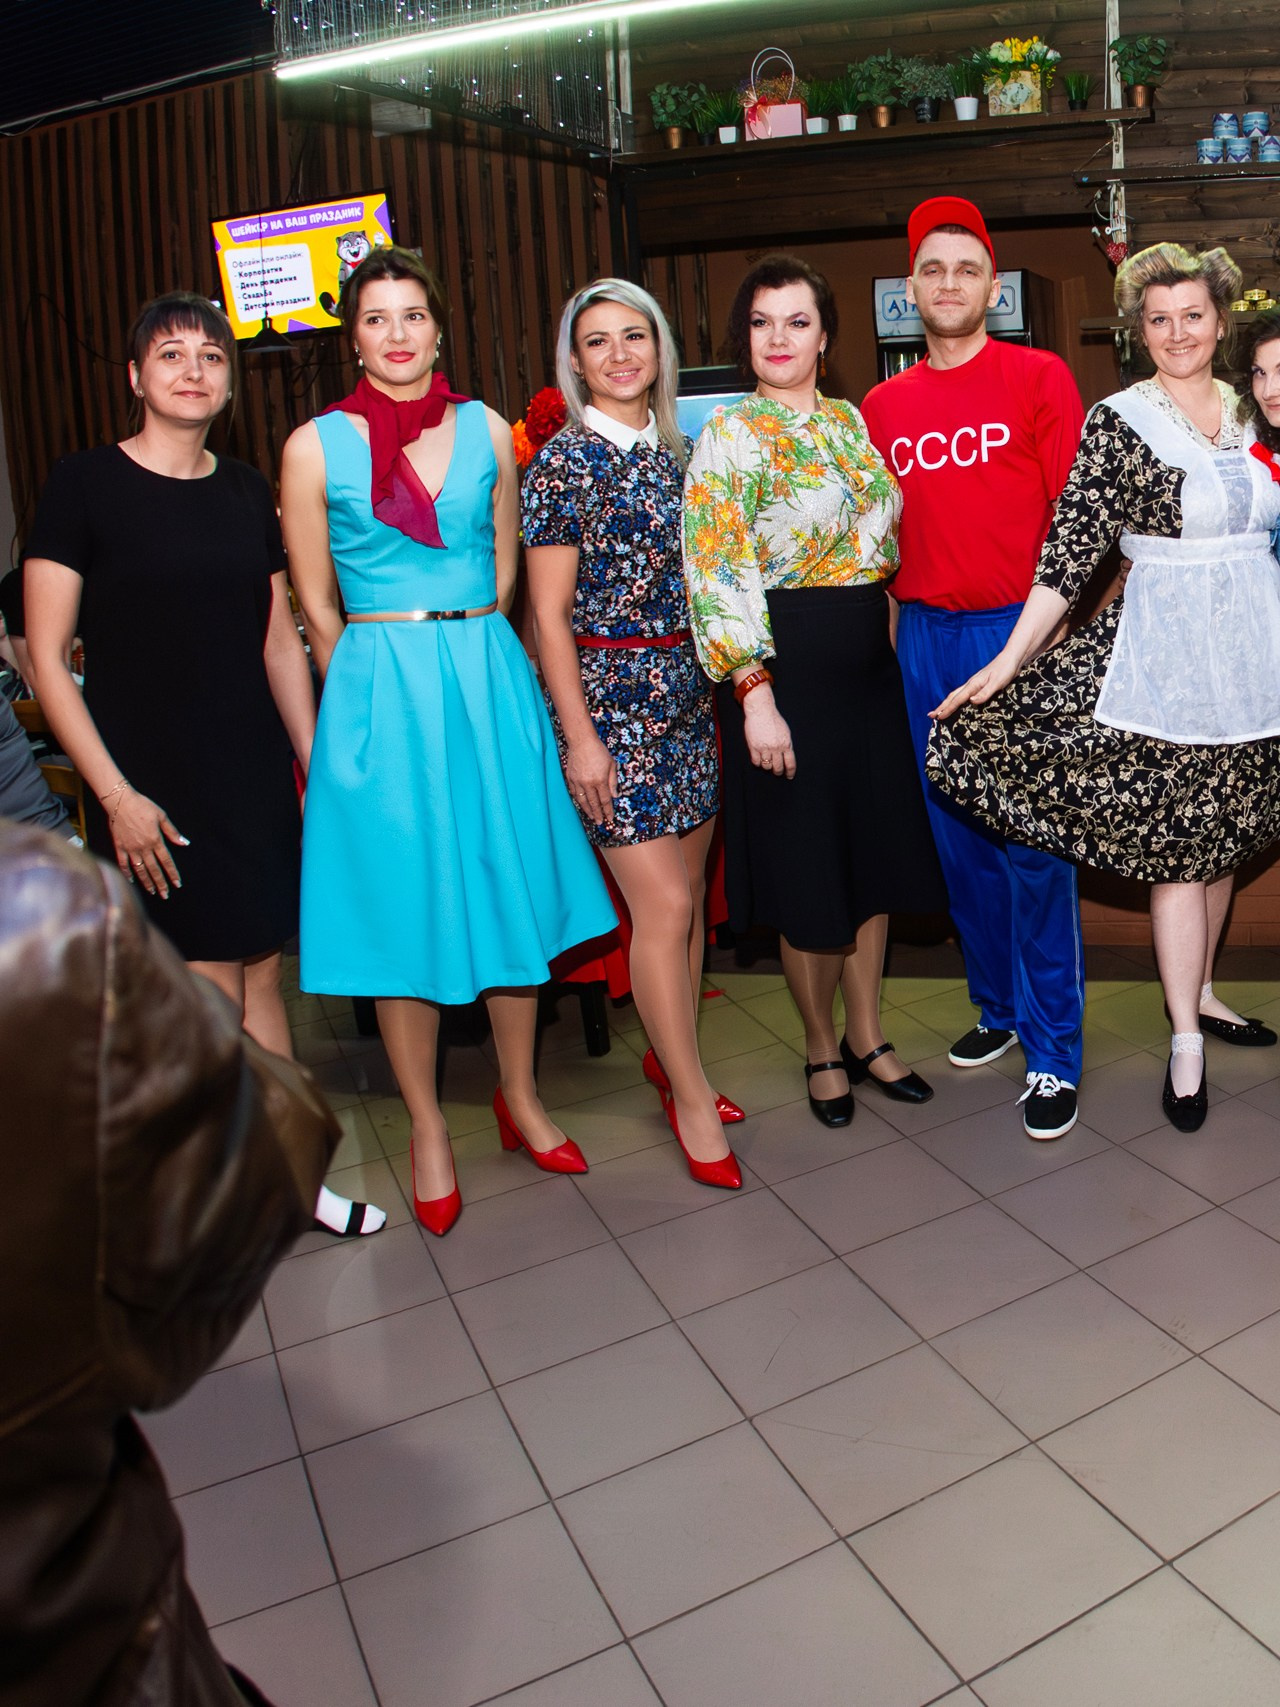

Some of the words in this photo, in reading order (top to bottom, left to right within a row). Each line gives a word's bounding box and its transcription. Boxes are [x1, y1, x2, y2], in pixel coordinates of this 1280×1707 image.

[231, 221, 269, 238] ШЕЙКЕР
[270, 219, 284, 231] НА
[285, 214, 308, 229] ВАШ
[309, 206, 362, 224] ПРАЗДНИК
[238, 266, 283, 279] Корпоратив
[240, 281, 258, 291] День
[260, 275, 297, 288] рождения
[242, 289, 273, 300] Свадьба
[244, 301, 275, 312] Детский
[276, 295, 311, 307] праздник
[891, 422, 1011, 477] СССР
